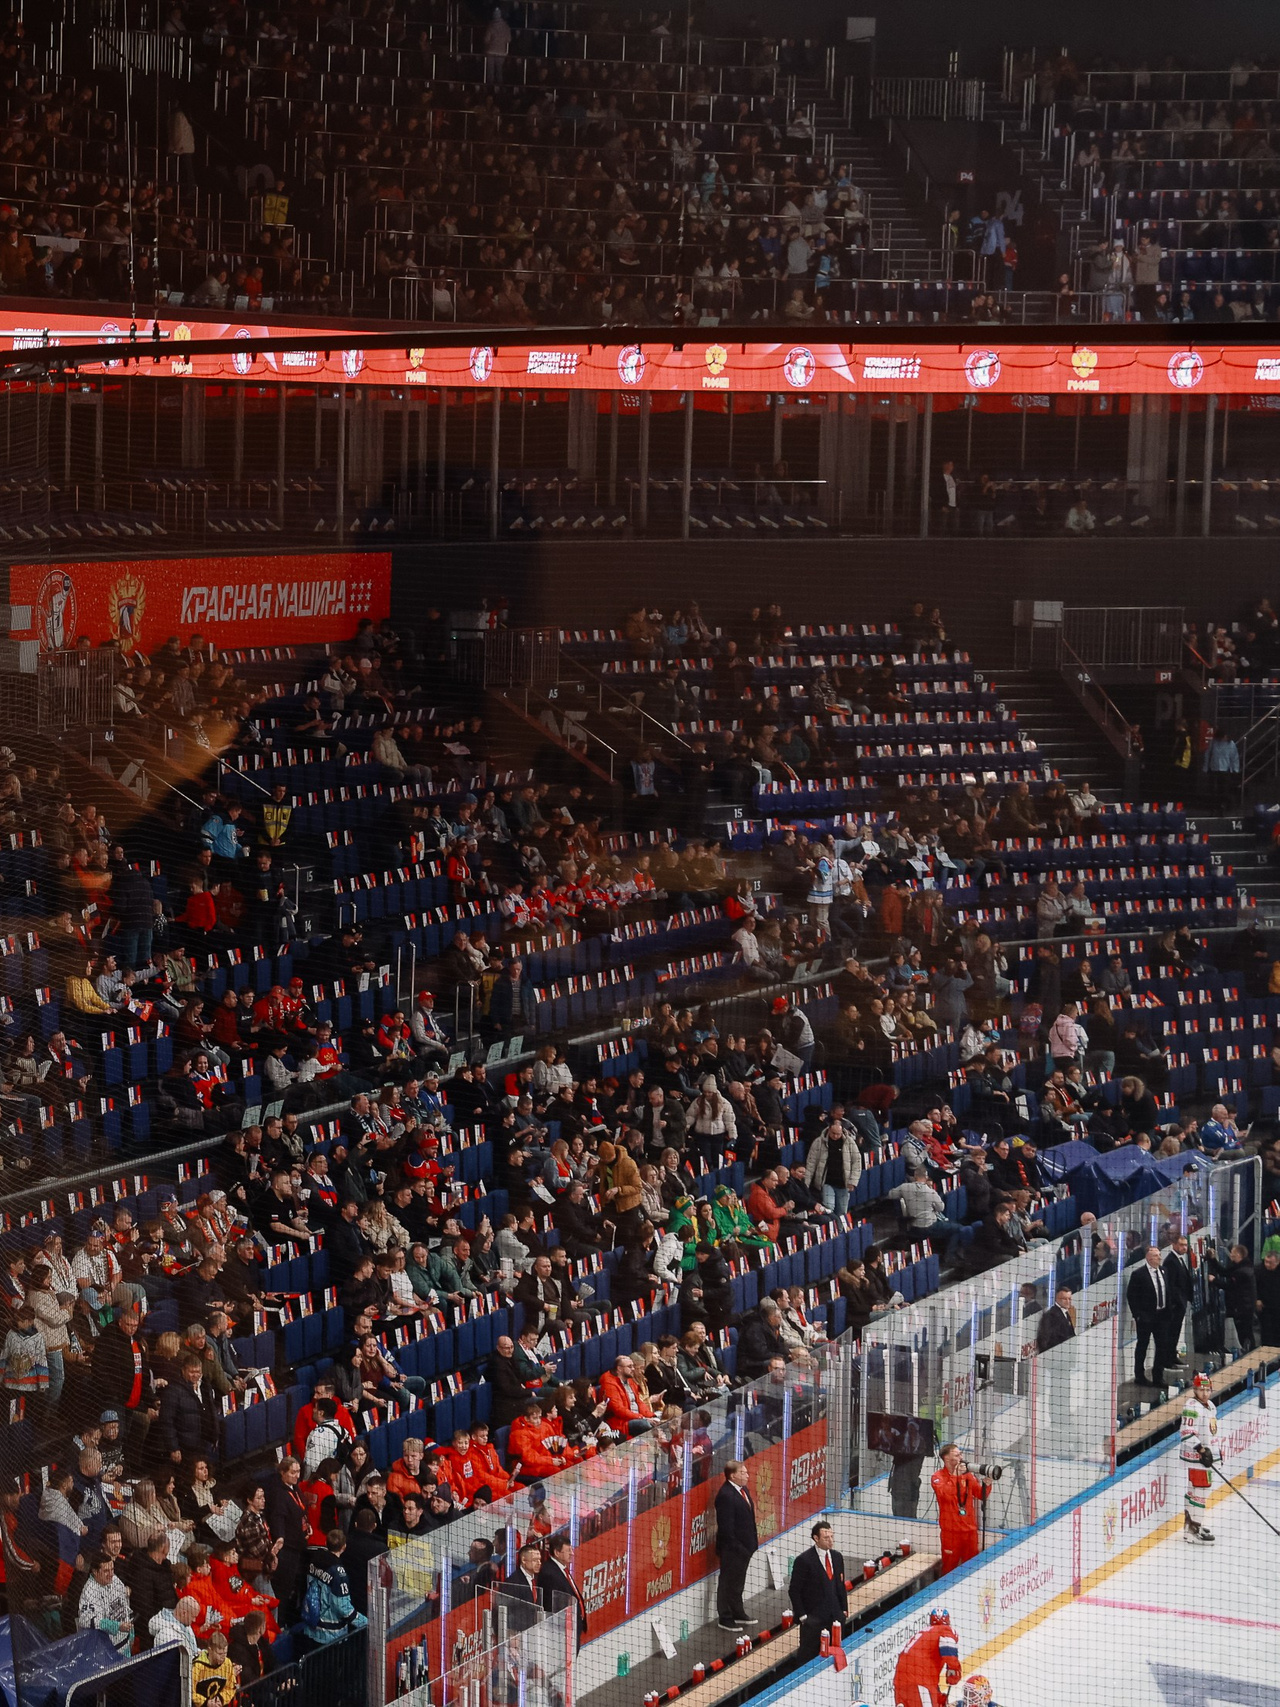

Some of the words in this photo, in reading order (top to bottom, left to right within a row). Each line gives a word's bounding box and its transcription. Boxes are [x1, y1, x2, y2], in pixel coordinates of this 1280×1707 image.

[180, 583, 272, 624] КРАСНАЯ
[272, 579, 347, 618] МАШИНА
[548, 688, 559, 699] A5
[734, 807, 743, 819] 15
[1185, 821, 1196, 831] 14
[1231, 820, 1242, 830] 14
[1210, 855, 1222, 865] 13
[1257, 855, 1268, 865] 13
[306, 870, 314, 882] 15
[753, 880, 761, 892] 13
[801, 913, 809, 925] 12
[304, 920, 312, 932] 14
[790, 1451, 810, 1490] RED
[1121, 1474, 1167, 1532] FHR.RU
[1000, 1552, 1039, 1591] ФЕДЕРАЦИЯ
[582, 1560, 609, 1601] RED
[646, 1569, 673, 1602] РОССИЯ
[340, 1582, 349, 1595] 13
[1000, 1581, 1026, 1611] ХОККЕЯ
[1026, 1564, 1055, 1595] РОССИИ
